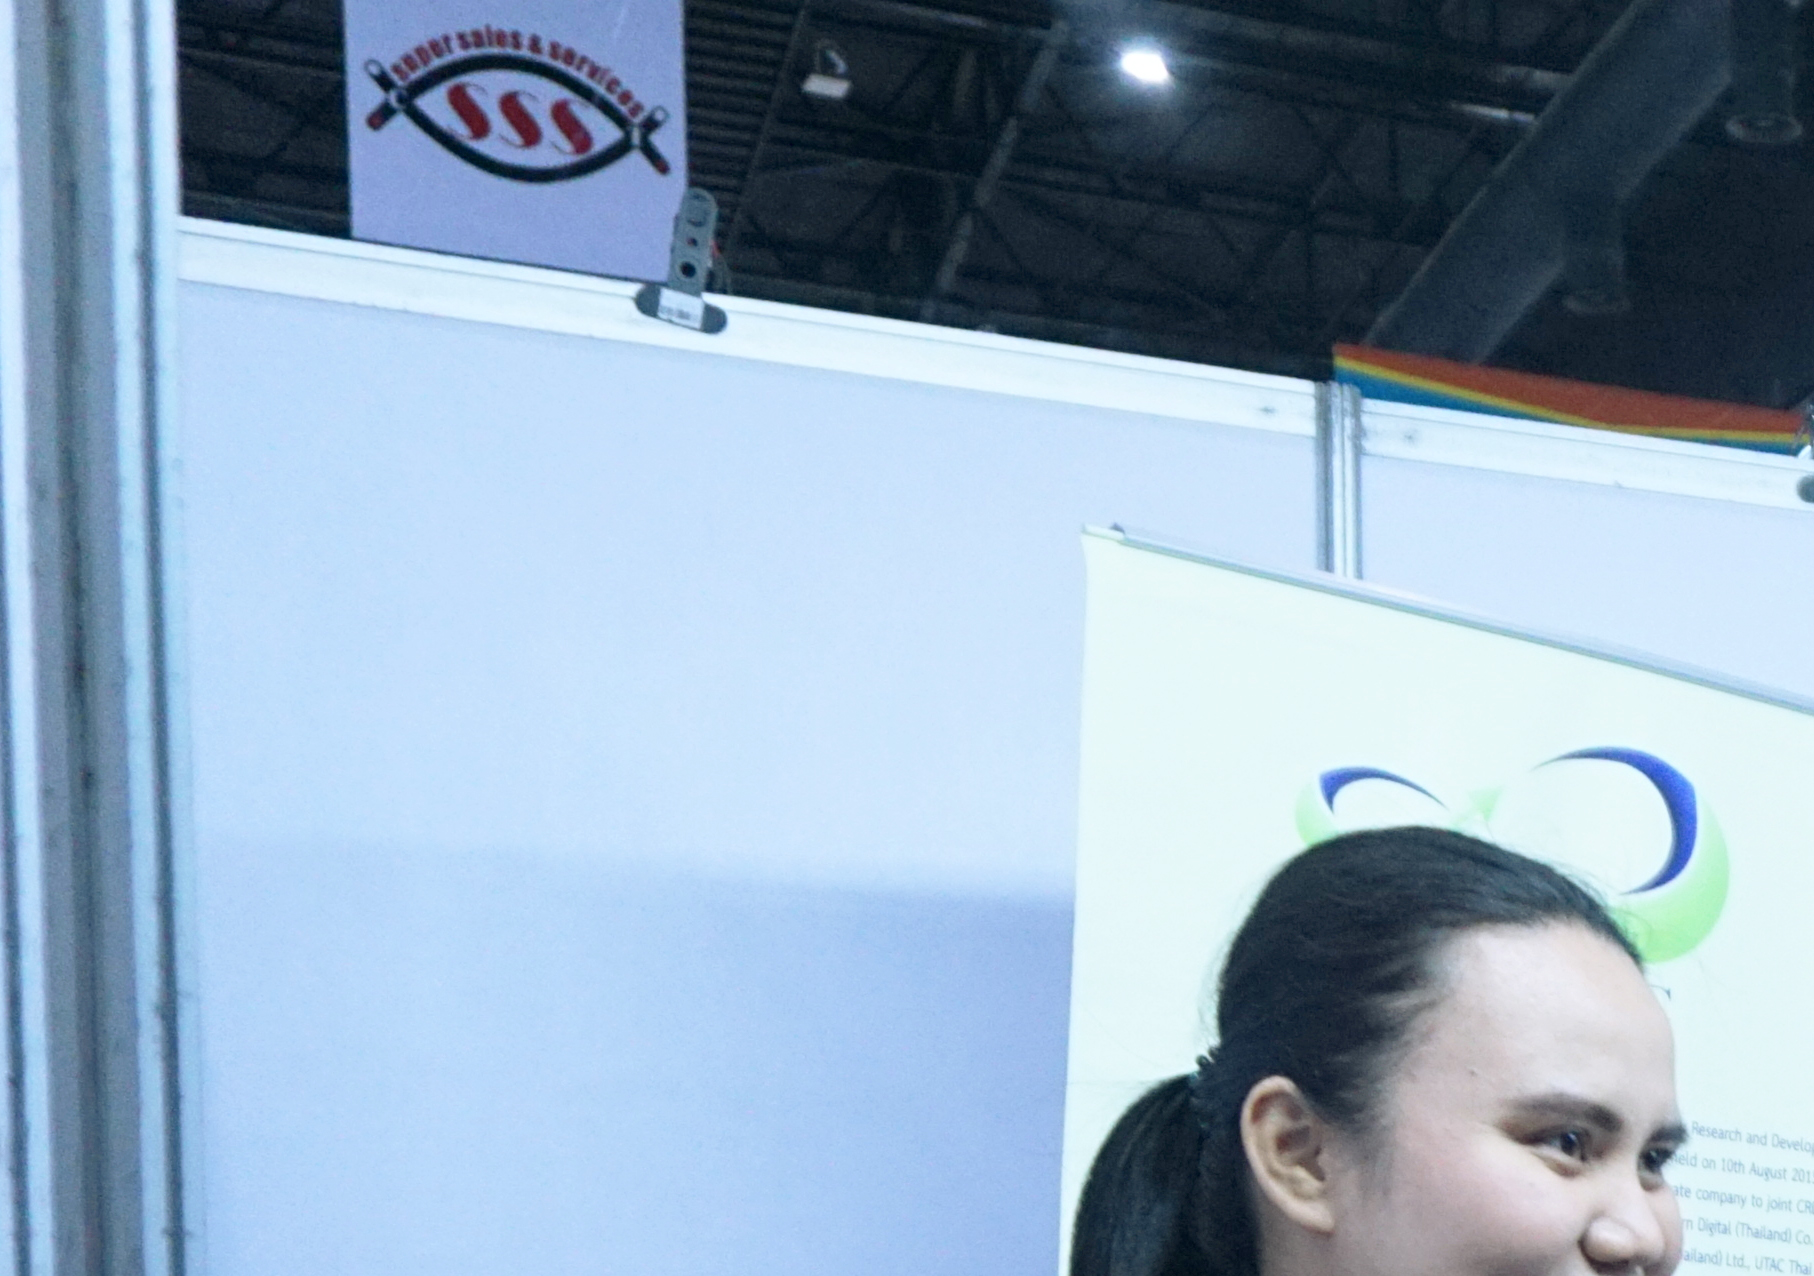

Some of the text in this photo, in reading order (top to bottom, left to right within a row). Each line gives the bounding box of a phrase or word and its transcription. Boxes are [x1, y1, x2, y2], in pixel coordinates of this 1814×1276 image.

[391, 24, 644, 119] super sales & services
[1692, 1121, 1742, 1144] Research
[1747, 1130, 1767, 1147] and
[1702, 1156, 1716, 1170] on
[1721, 1157, 1745, 1175] 10th
[1750, 1161, 1787, 1182] August
[1695, 1185, 1746, 1208] company
[1751, 1195, 1764, 1209] to
[1766, 1196, 1792, 1216] joint
[1698, 1217, 1732, 1237] Digital
[1735, 1220, 1792, 1244] (Thailand)
[1795, 1230, 1814, 1246] Co.
[1726, 1252, 1750, 1270] Ltd.,
[1755, 1256, 1784, 1273] UTAC
[1789, 1259, 1812, 1275] Thai
